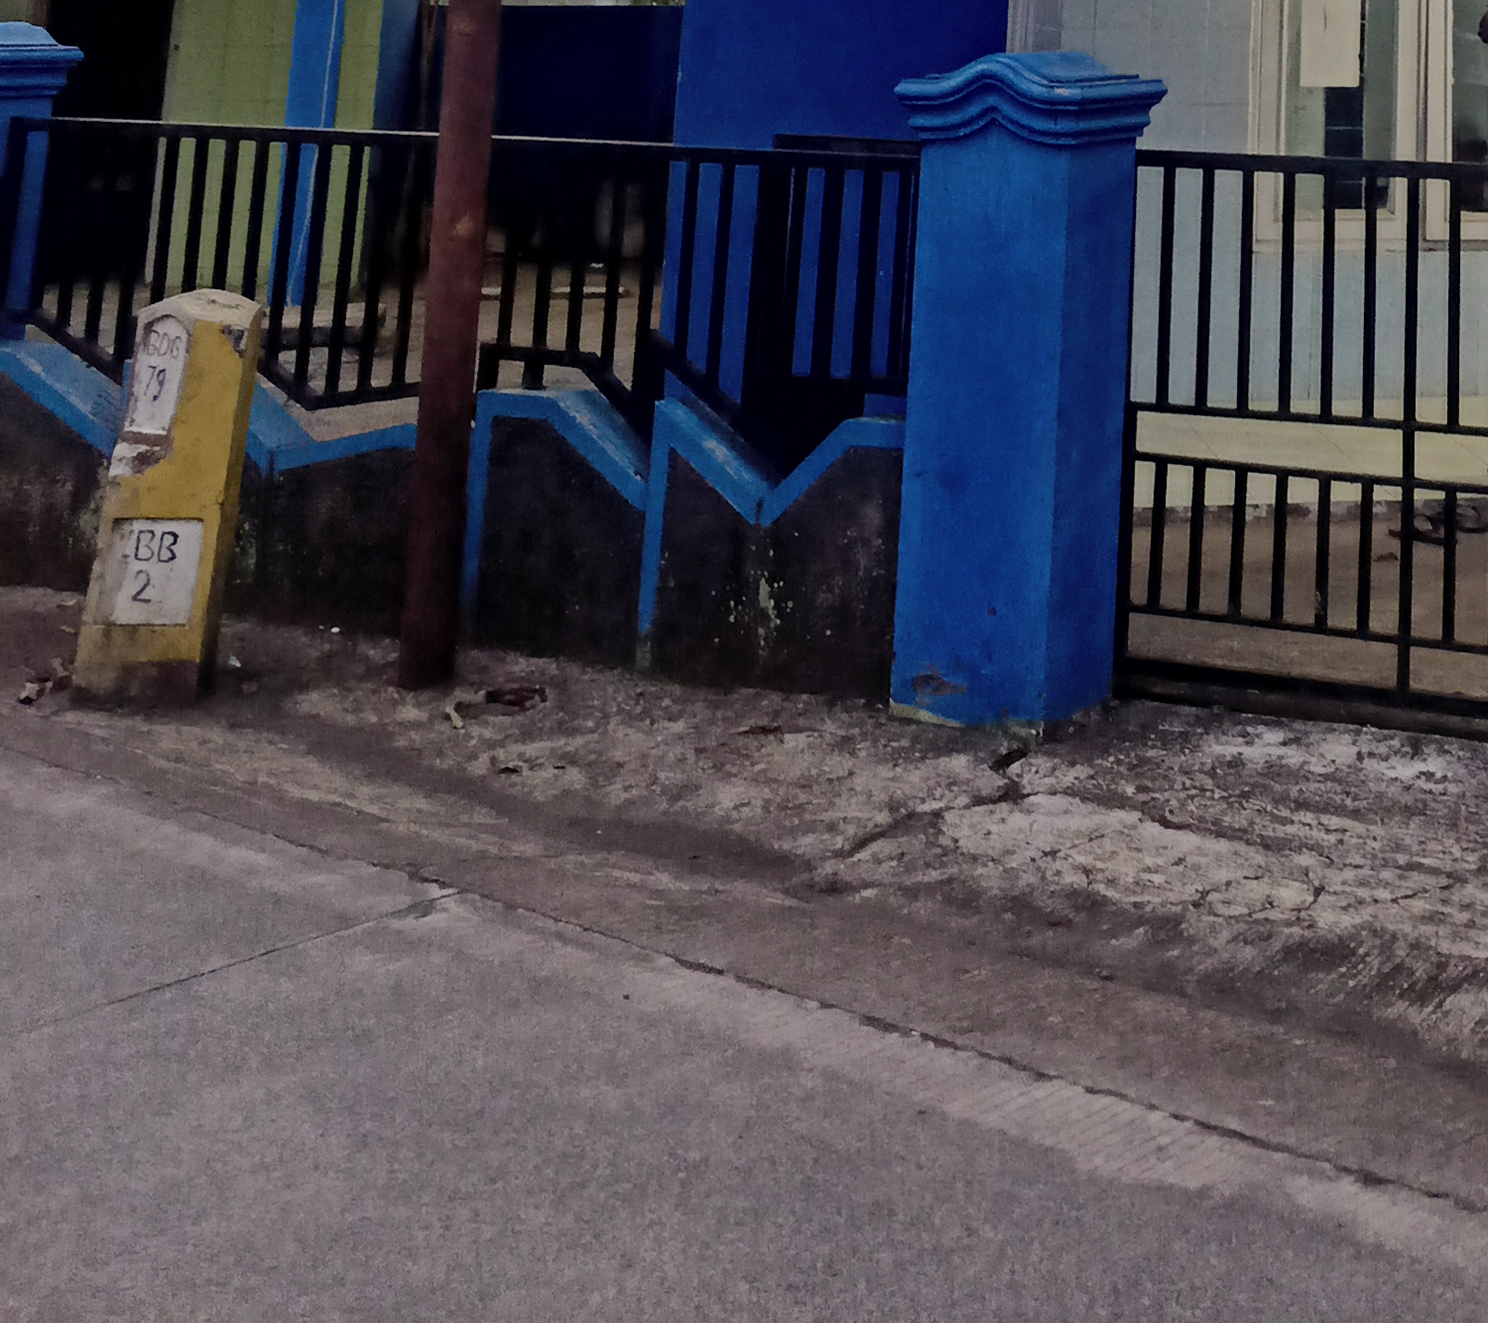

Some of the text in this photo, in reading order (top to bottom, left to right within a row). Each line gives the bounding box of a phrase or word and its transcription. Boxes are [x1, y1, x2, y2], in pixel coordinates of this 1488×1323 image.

[143, 365, 167, 402] 79
[134, 529, 180, 563] BB
[131, 569, 152, 604] 2
